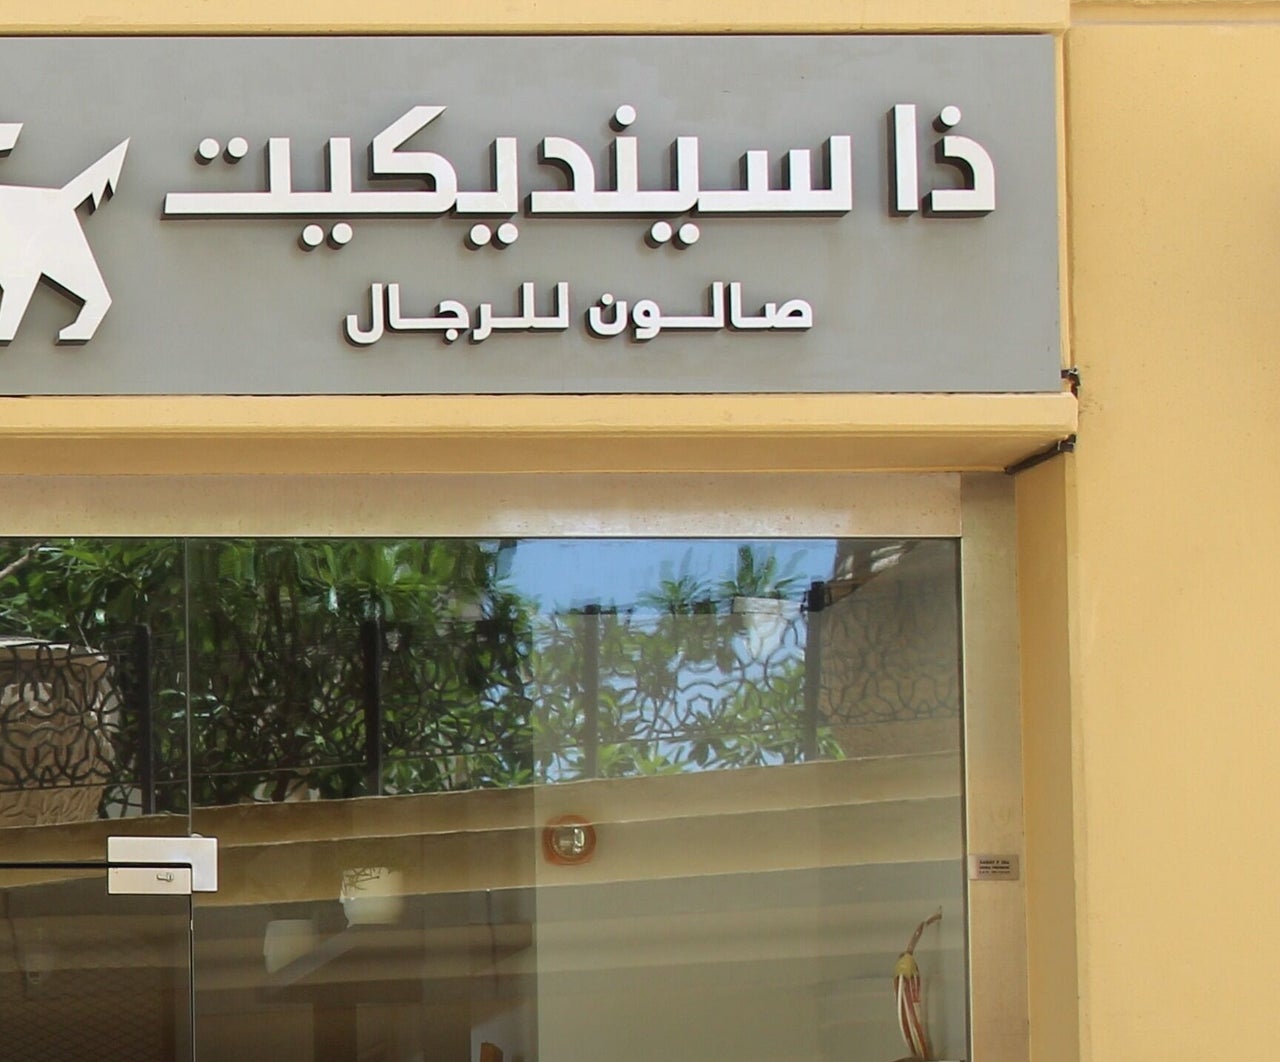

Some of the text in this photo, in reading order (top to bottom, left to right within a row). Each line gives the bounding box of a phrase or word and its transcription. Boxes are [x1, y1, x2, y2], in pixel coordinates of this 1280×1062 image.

[164, 103, 997, 246] ذا سينديكيت
[346, 281, 814, 344] صالون للرجال
